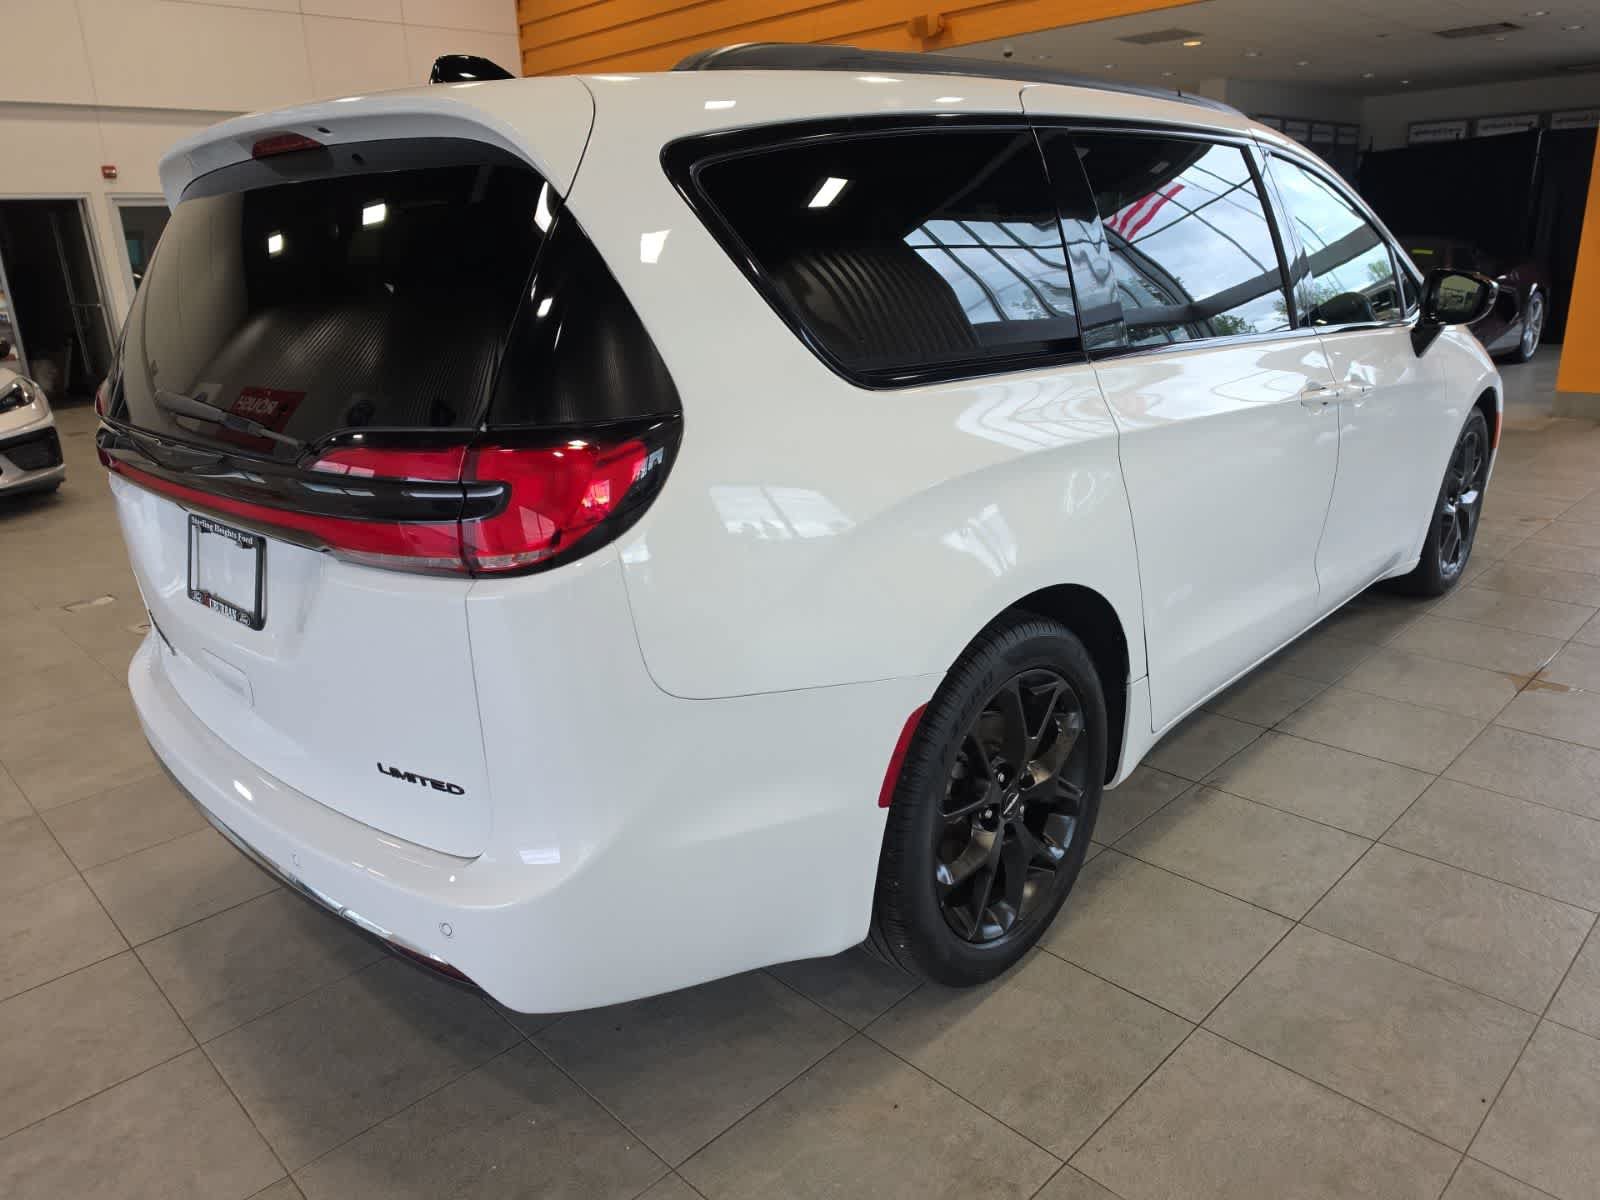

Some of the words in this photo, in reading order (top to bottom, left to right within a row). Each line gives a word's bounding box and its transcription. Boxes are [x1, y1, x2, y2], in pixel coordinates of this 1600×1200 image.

[214, 524, 237, 539] Heights
[238, 533, 253, 545] Ford
[377, 762, 465, 795] LIMITED
